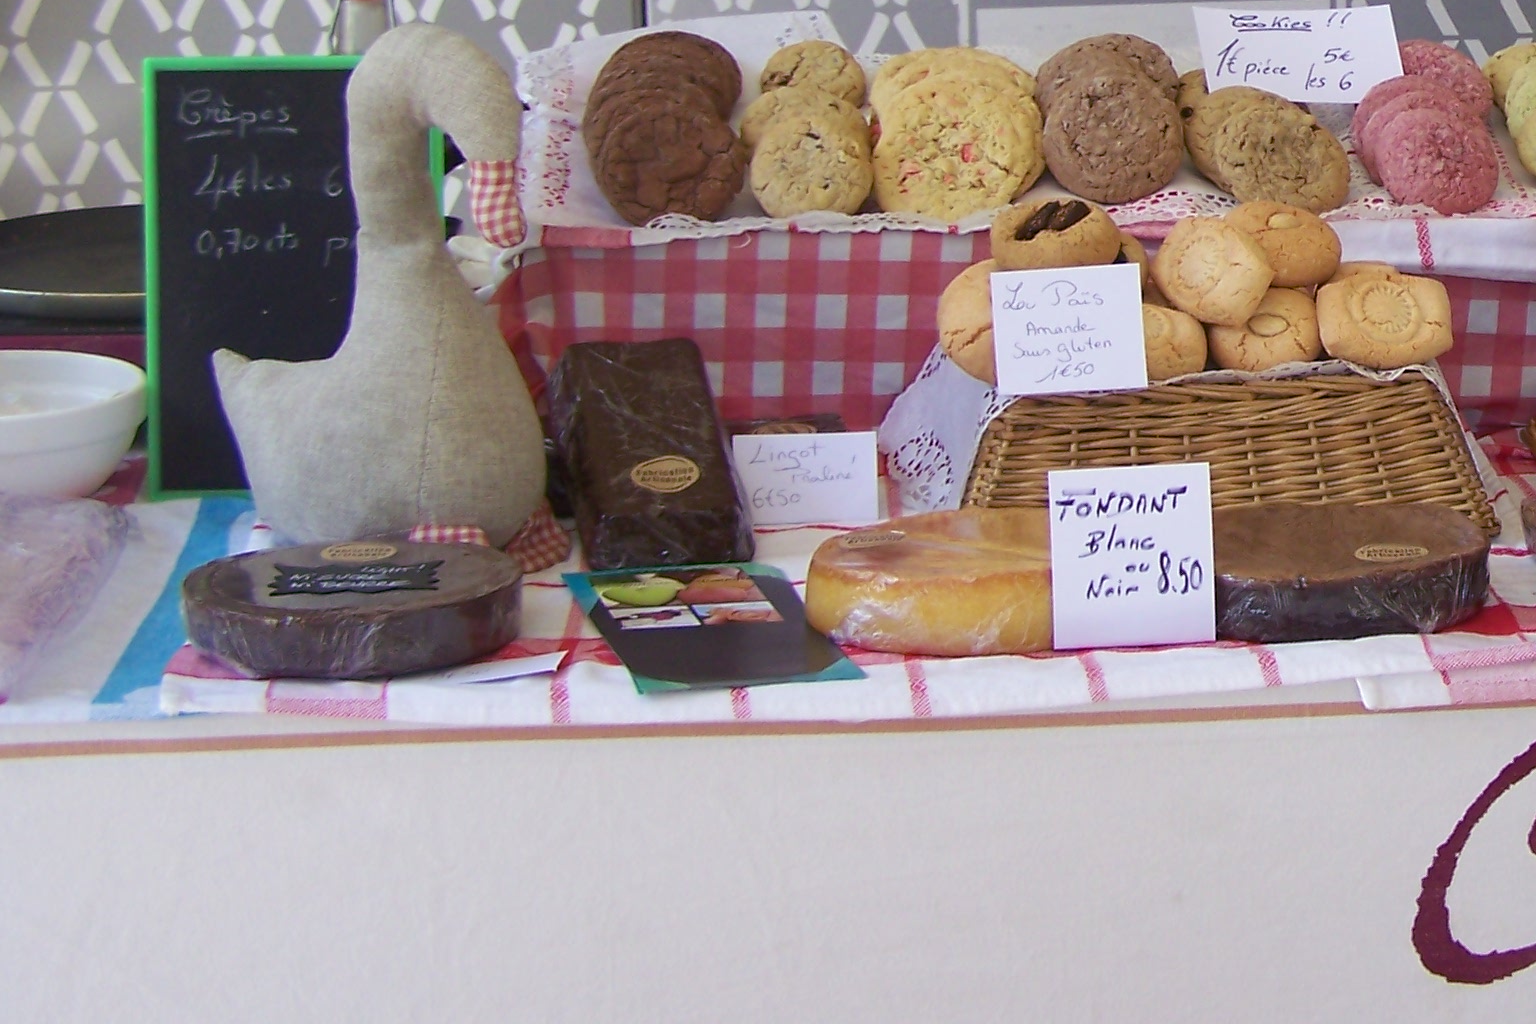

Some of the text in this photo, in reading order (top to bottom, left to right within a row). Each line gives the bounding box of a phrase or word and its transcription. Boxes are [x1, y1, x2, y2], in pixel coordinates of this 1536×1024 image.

[1338, 71, 1354, 91] 6
[1025, 316, 1097, 337] Amande
[1078, 524, 1155, 558] Blanc
